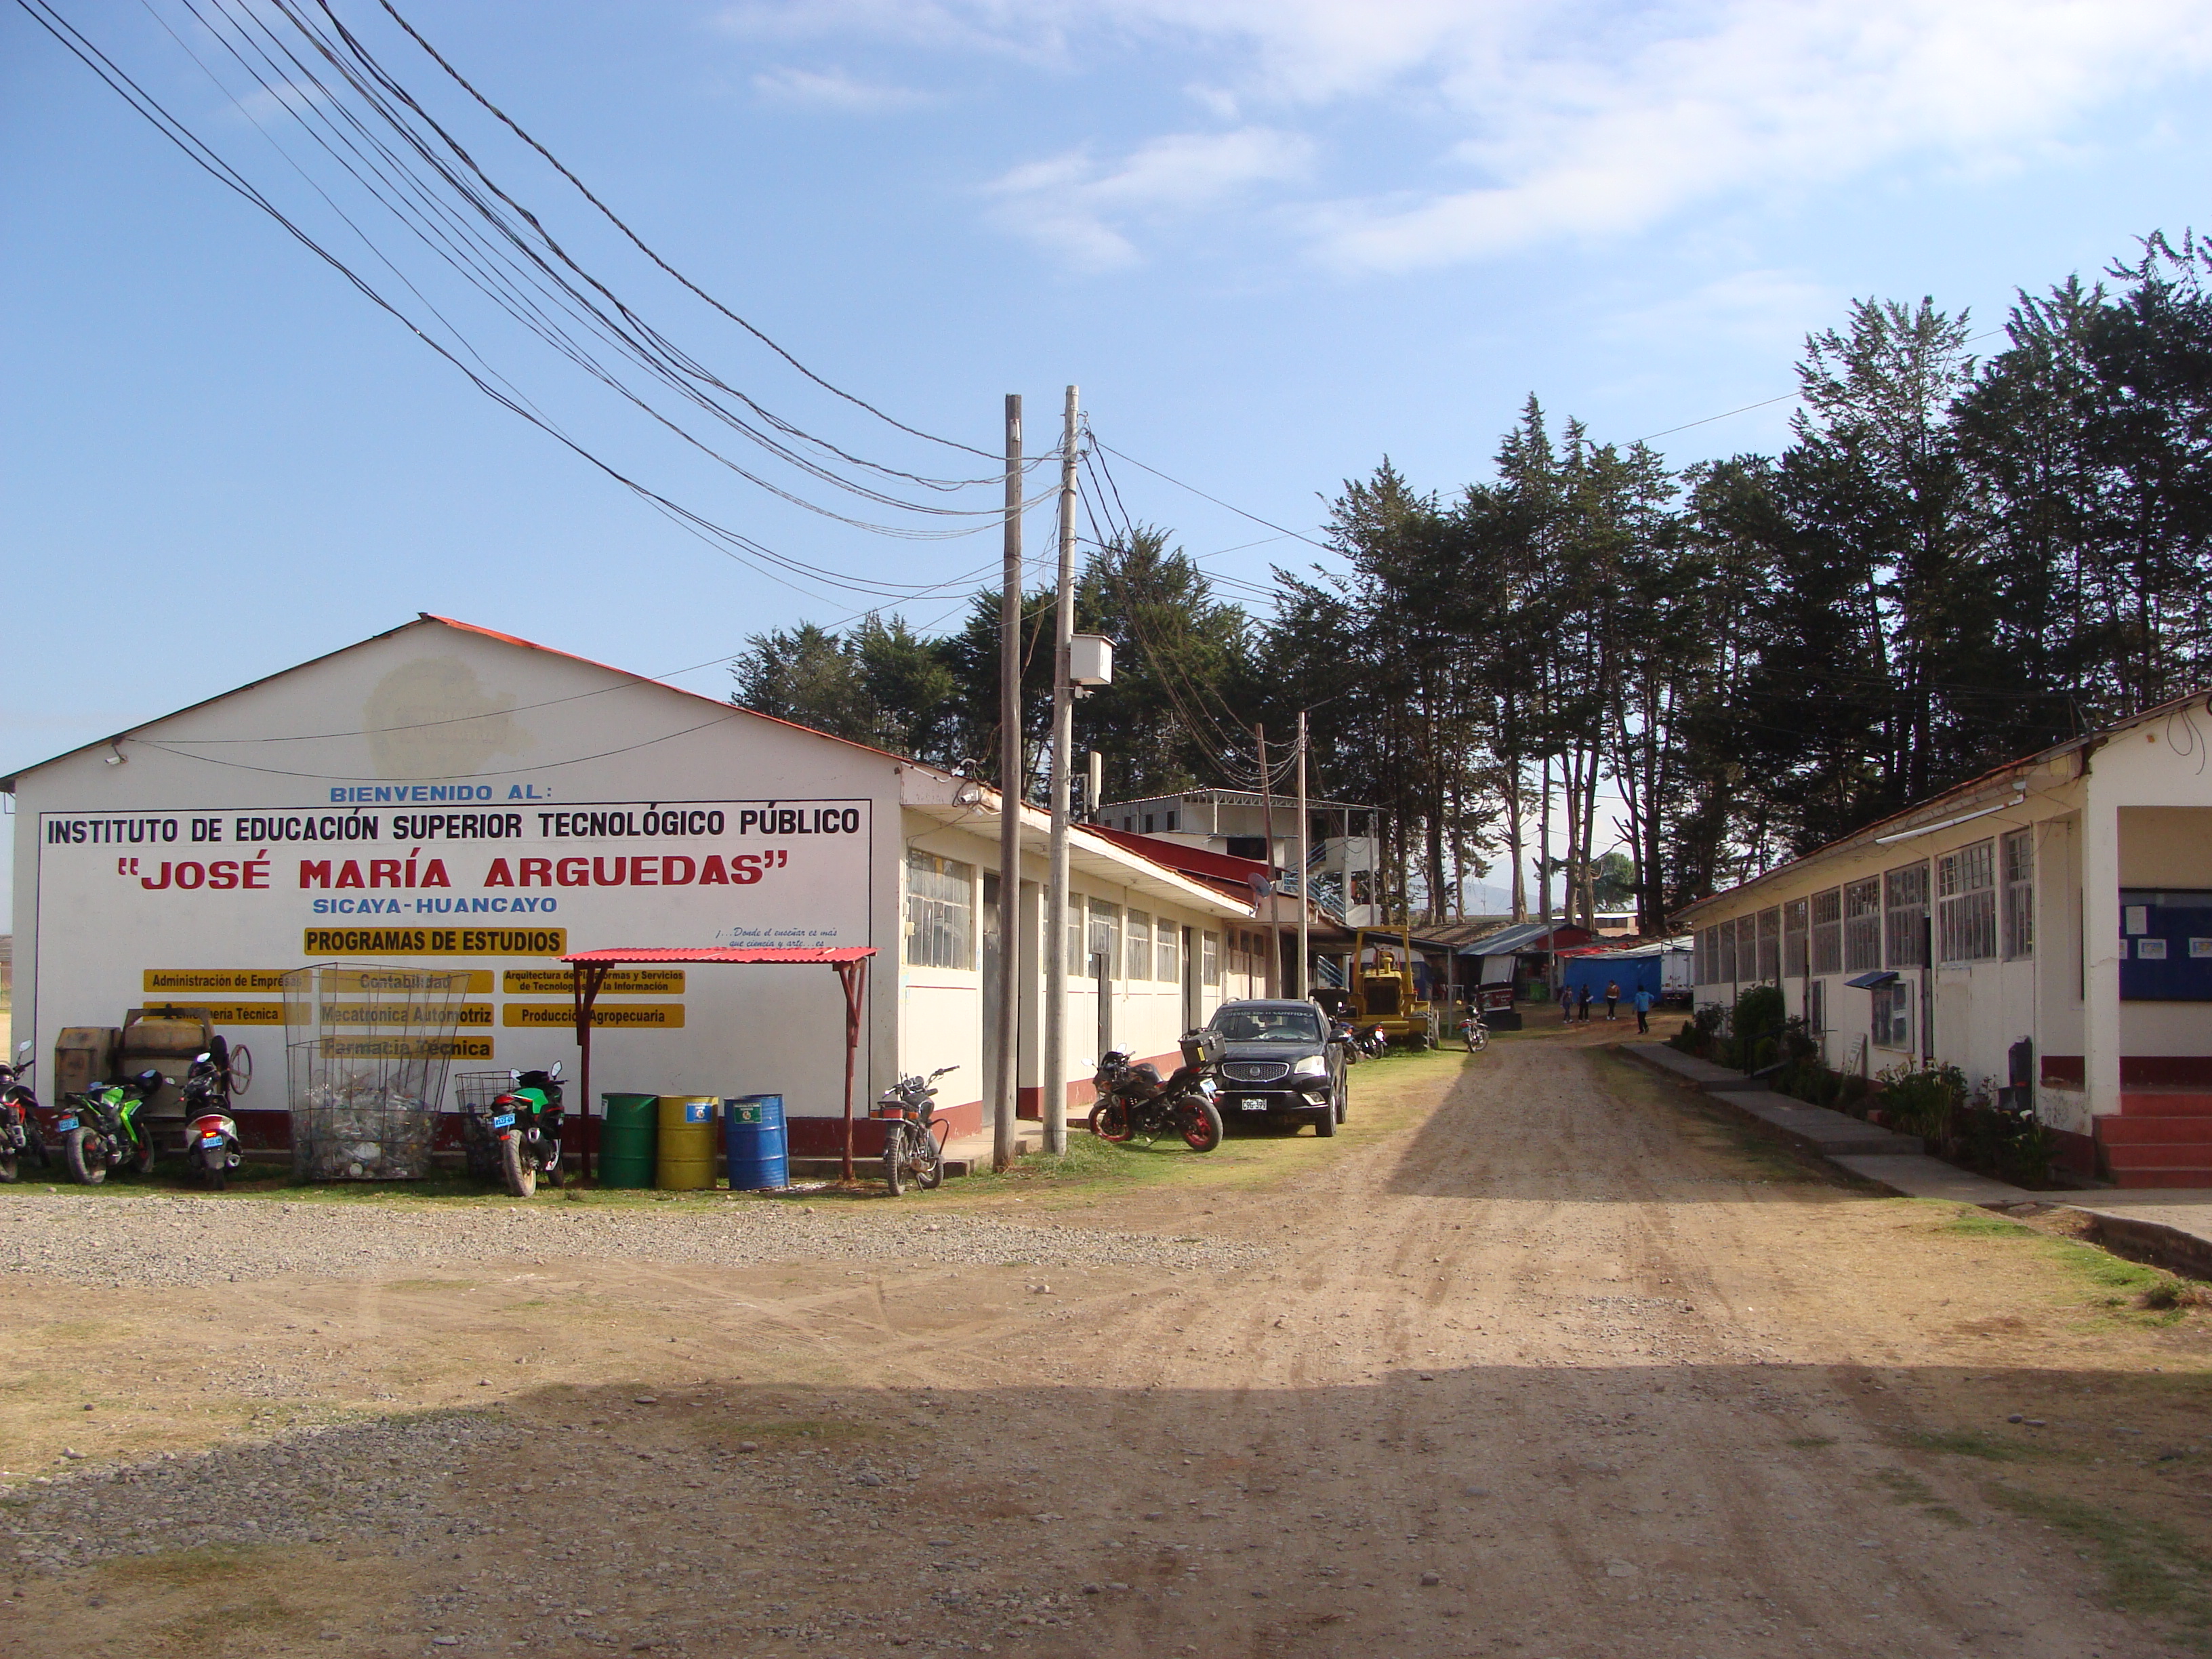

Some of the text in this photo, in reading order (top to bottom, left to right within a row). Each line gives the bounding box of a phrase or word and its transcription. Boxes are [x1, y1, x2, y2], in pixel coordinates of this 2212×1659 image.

[330, 784, 552, 802] BIENVENIDO AL:
[48, 800, 859, 844] INSTITUTO DE EDUCACIÓN SUPERIOR TECNOLÓGICO PÚBLICO
[300, 847, 451, 888] MARÍA
[313, 897, 557, 914] SICAYA-HUANCAYO
[307, 931, 560, 951] PROGRAMAS DE ESTUDIOS
[774, 928, 805, 937] enseñar
[820, 928, 837, 937] más
[152, 974, 231, 987] Administración
[234, 975, 247, 987] de
[506, 970, 560, 981] Arquitectura
[563, 971, 574, 979] de
[634, 973, 639, 982] y
[641, 970, 683, 980] Servicios
[520, 981, 668, 992] de Tecnologs la Información
[236, 1006, 279, 1019] Técnica
[321, 1006, 492, 1023] Mecatrónica Automotriz
[522, 1008, 665, 1025] Producció Agropecuaria
